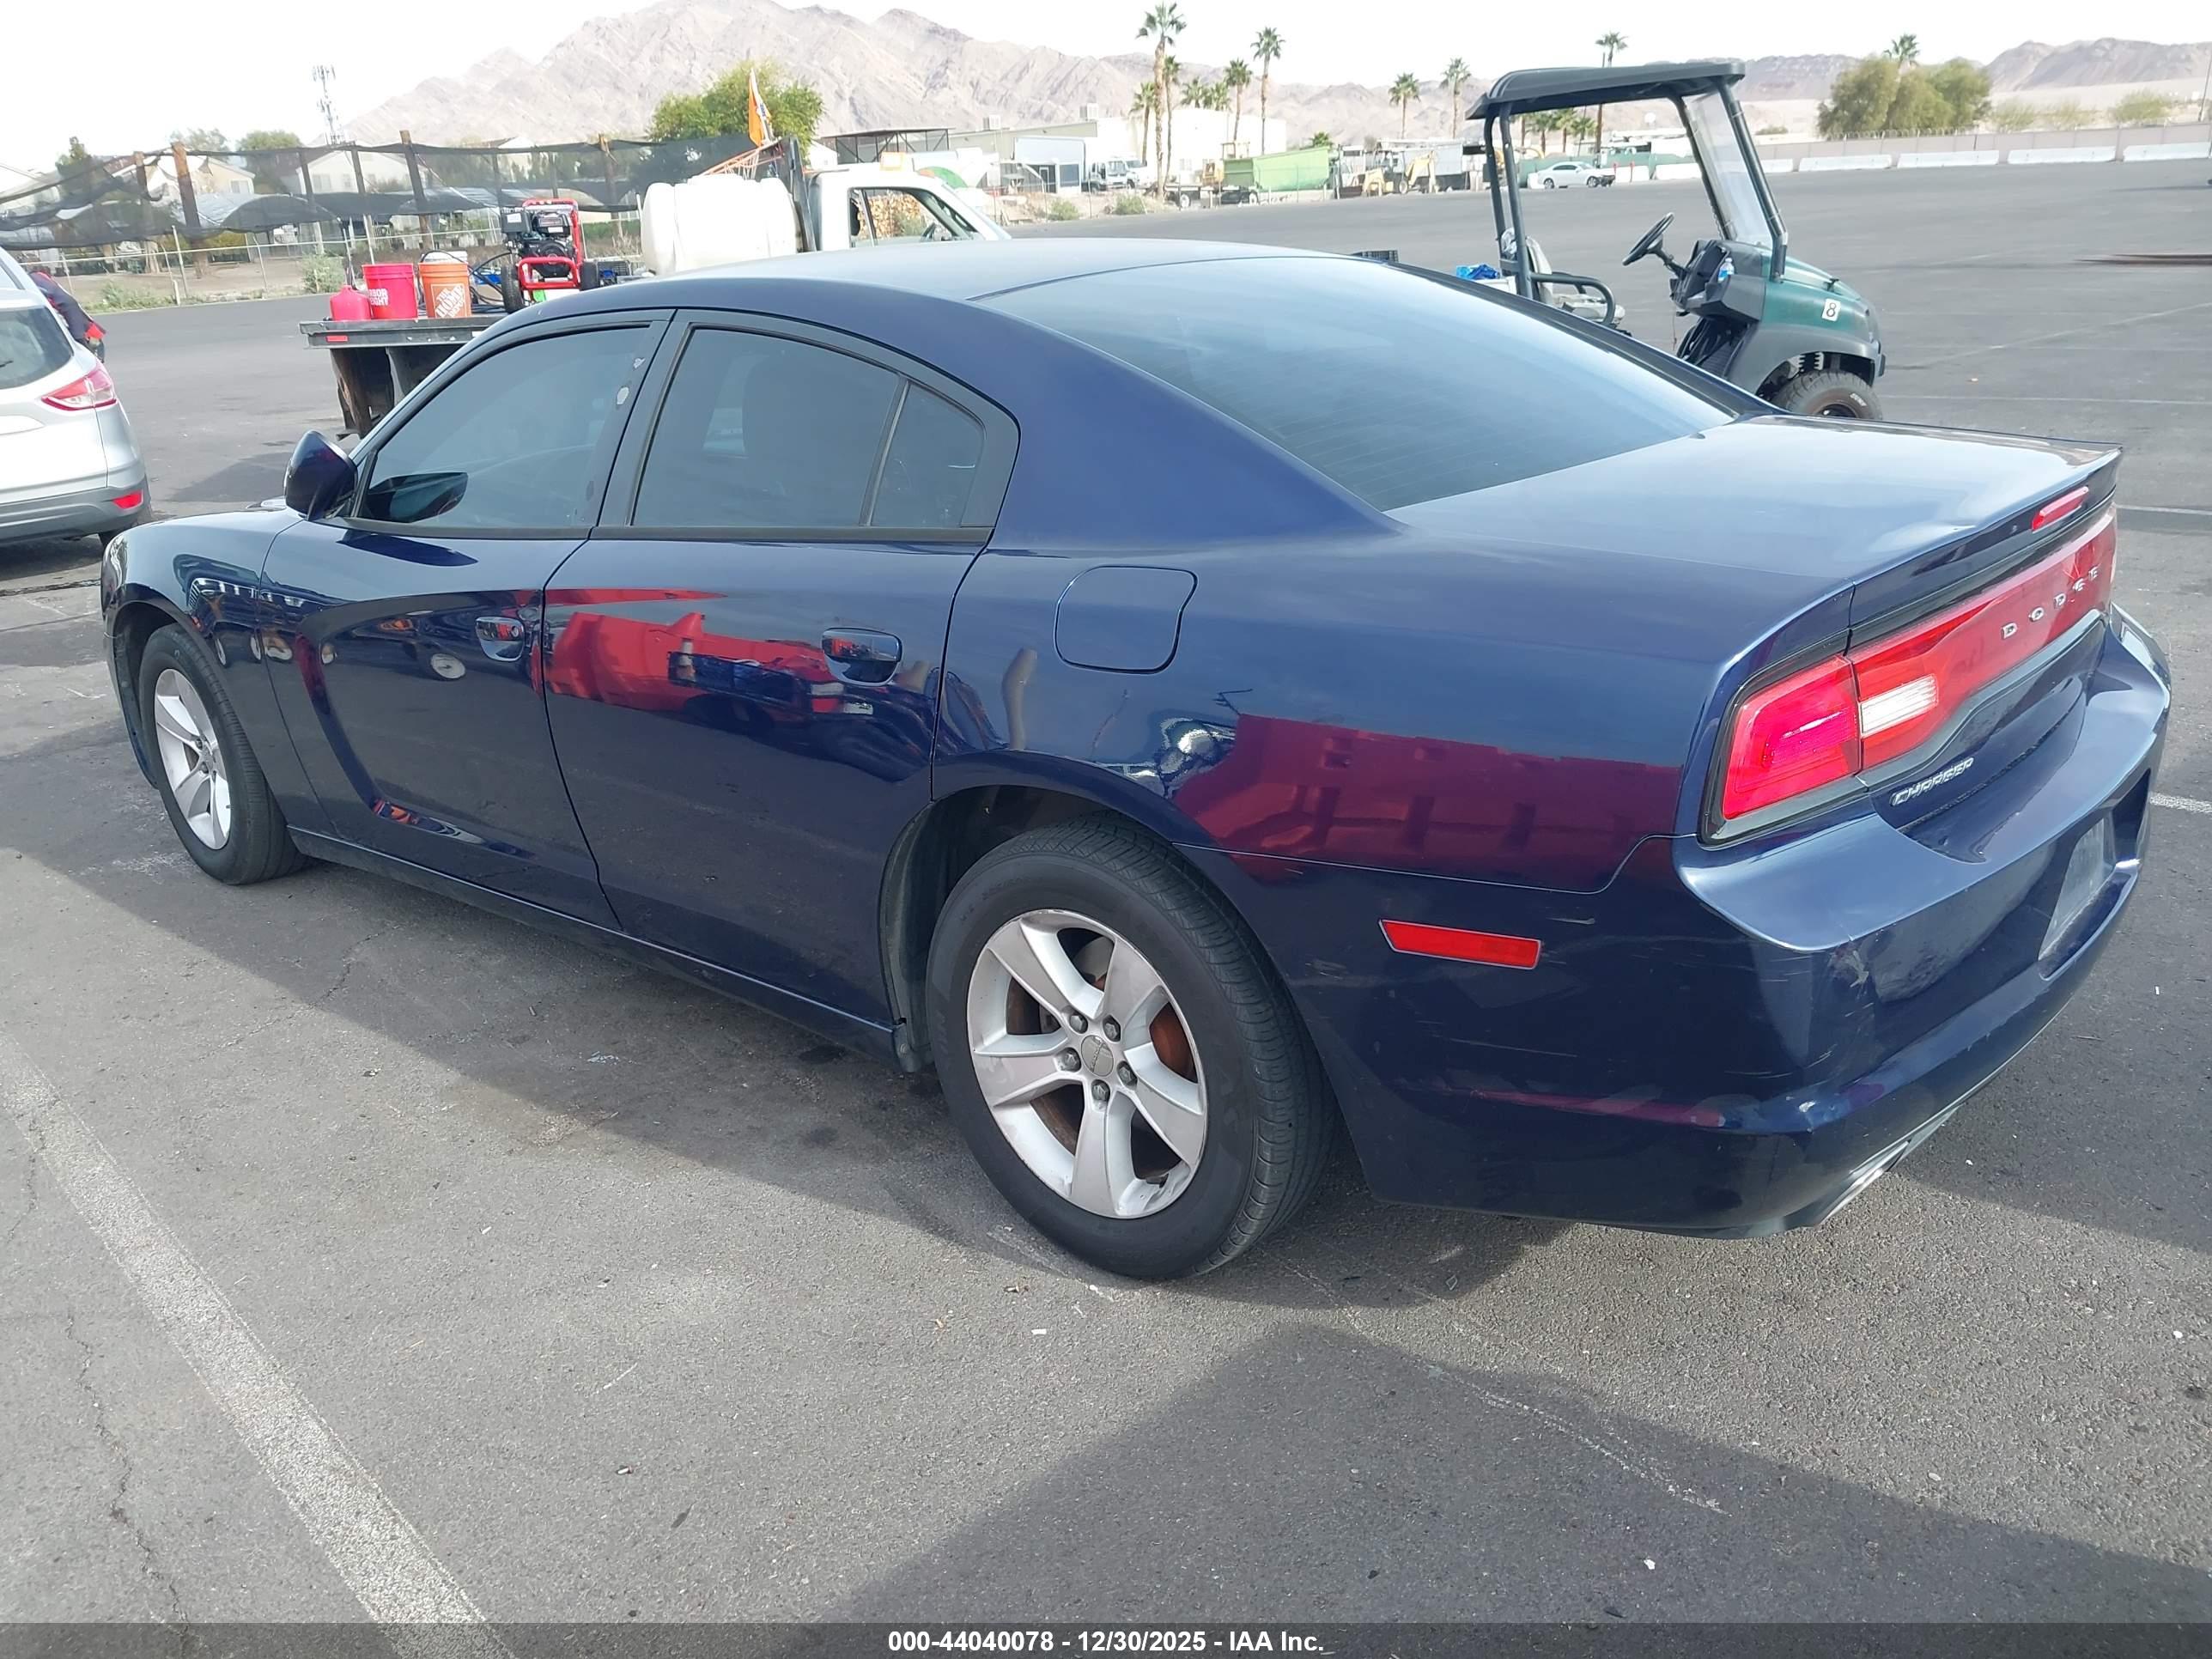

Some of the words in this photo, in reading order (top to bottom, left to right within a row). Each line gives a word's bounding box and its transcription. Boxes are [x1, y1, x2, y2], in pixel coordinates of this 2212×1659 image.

[435, 285, 464, 318] HOME
[1826, 302, 1836, 317] 8
[2002, 565, 2099, 639] DODGE
[1890, 757, 1974, 805] CHARGER
